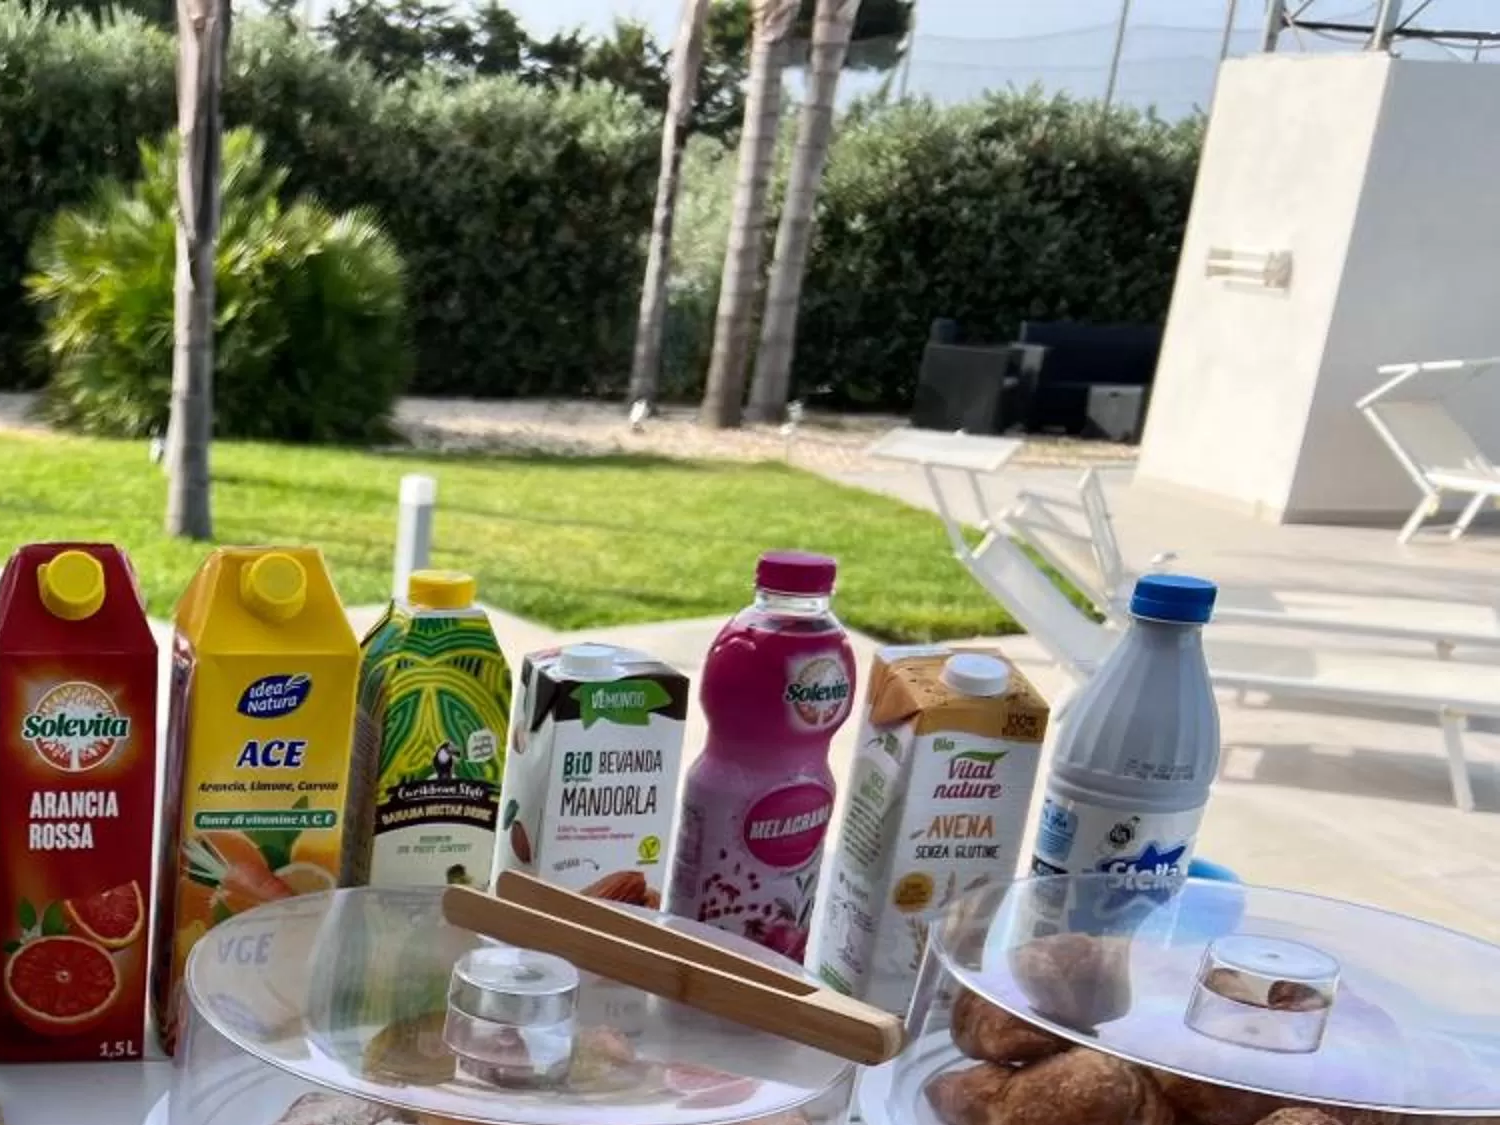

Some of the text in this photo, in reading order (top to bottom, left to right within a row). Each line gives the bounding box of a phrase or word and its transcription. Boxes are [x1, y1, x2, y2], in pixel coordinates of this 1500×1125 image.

[250, 682, 282, 698] Idea
[247, 695, 297, 712] Natura
[23, 711, 129, 739] Solevita
[237, 740, 305, 767] ACE
[599, 750, 663, 774] BEVANDA
[948, 758, 997, 779] Vital
[560, 785, 657, 816] MANDORLA
[932, 782, 1001, 799] nature
[29, 791, 119, 819] ARANCIA
[29, 822, 93, 850] ROSSA
[926, 815, 995, 838] AVENA
[915, 846, 949, 860] SENZA
